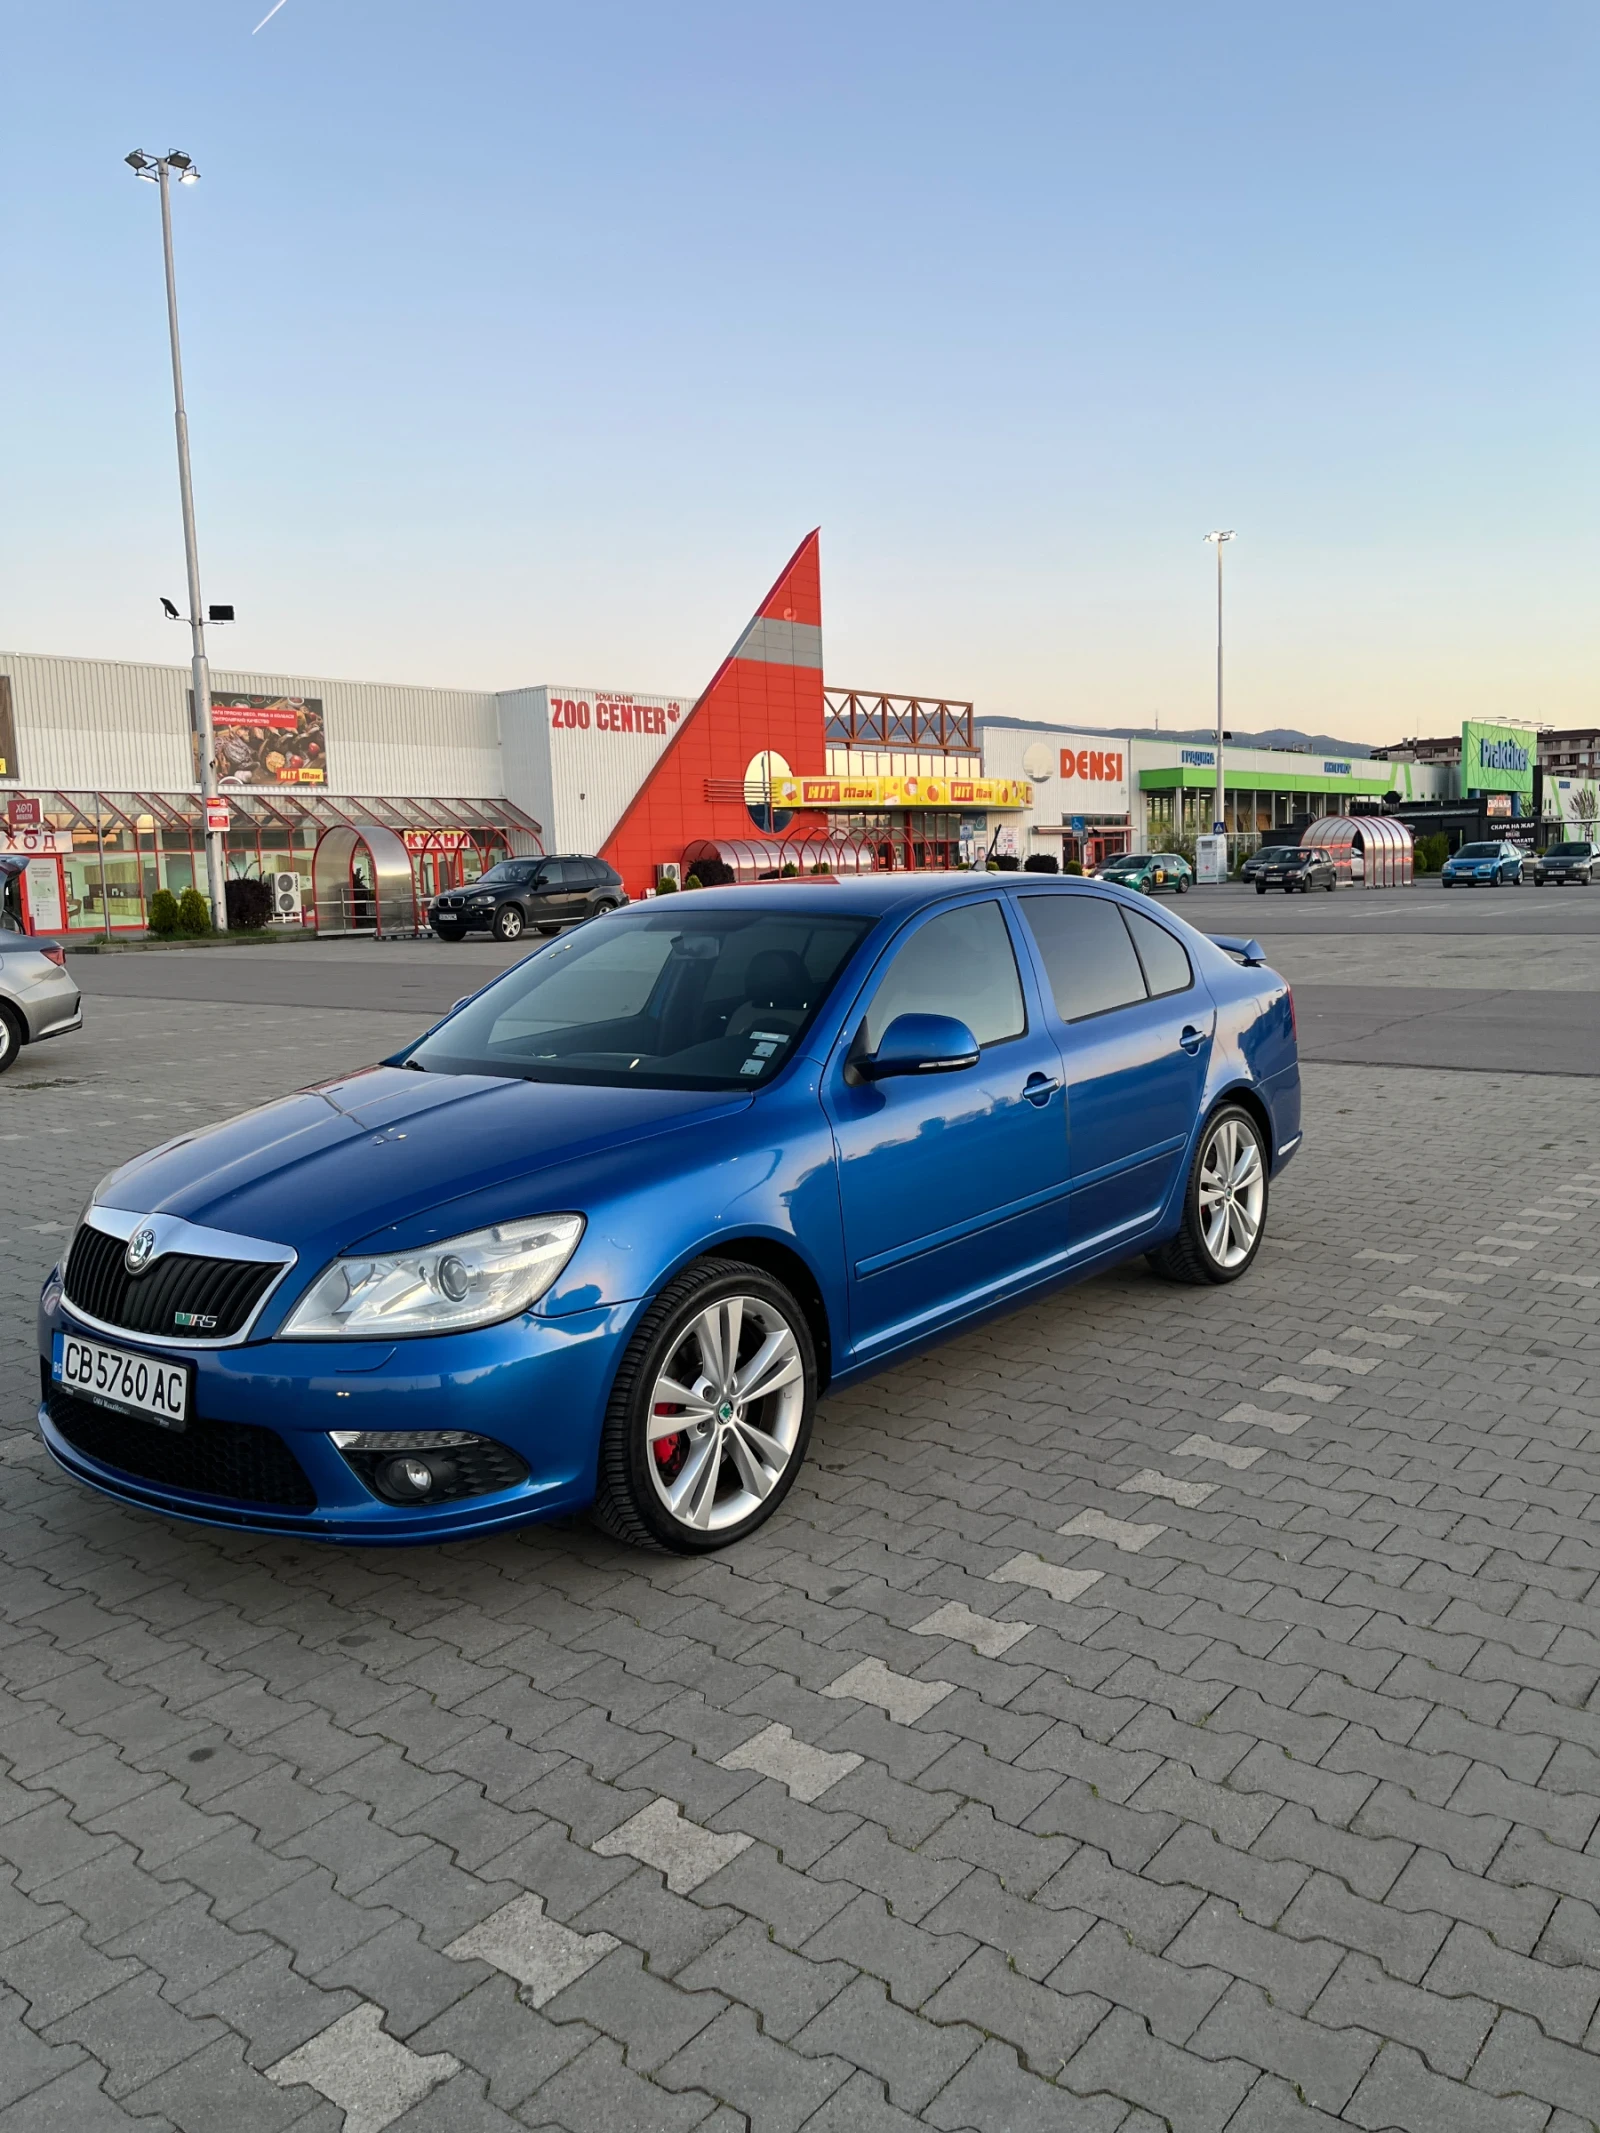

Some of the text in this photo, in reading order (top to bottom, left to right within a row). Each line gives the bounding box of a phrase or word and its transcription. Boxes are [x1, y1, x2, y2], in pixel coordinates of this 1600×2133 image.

[550, 698, 666, 734] ZOO CENTER
[1181, 750, 1215, 766] ГРАДИНА
[1481, 738, 1528, 771] Praktiker
[1060, 748, 1122, 781] DENSI
[280, 770, 297, 779] HIT
[807, 785, 873, 799] HIT Max
[953, 786, 971, 798] HIT
[407, 833, 468, 847] КУХНИ
[53, 1361, 62, 1374] BG
[65, 1342, 92, 1384] CB
[96, 1350, 148, 1401] 5760
[152, 1368, 182, 1413] AC
